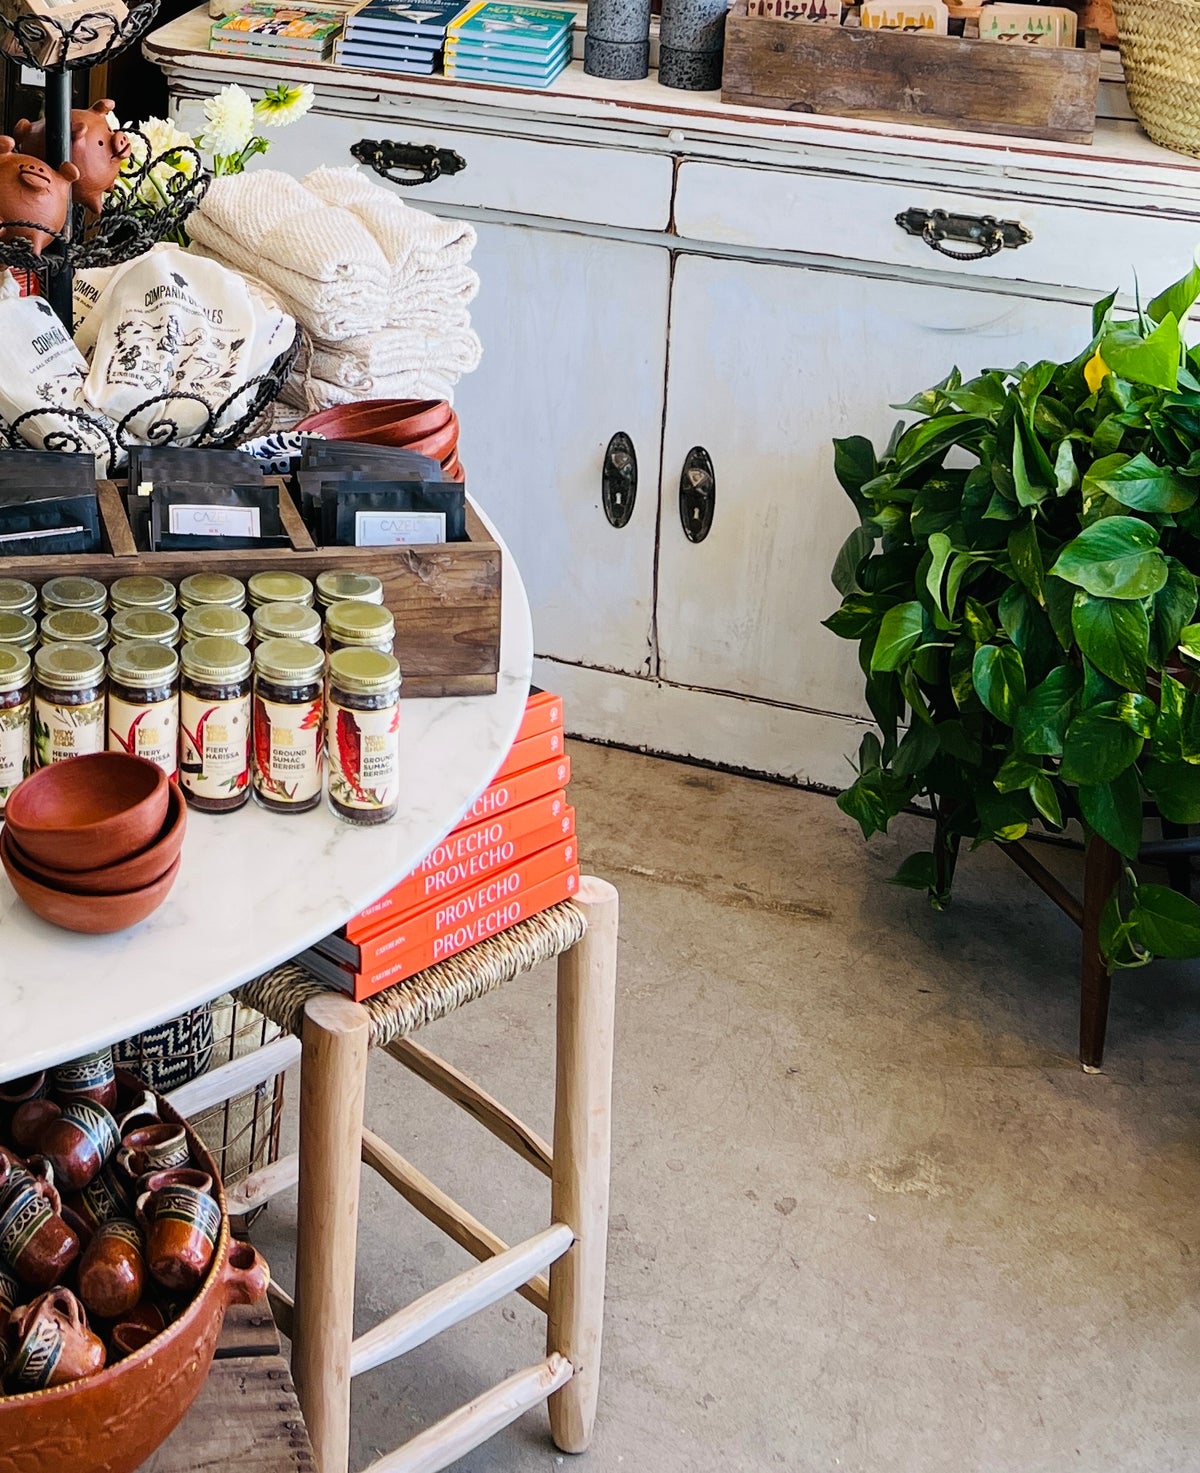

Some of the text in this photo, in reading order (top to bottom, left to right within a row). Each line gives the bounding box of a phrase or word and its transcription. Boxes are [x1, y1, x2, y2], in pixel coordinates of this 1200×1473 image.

[144, 284, 187, 307] COMPAÑIA
[31, 326, 66, 356] COMPAÑIA
[52, 750, 79, 758] HERBY
[205, 752, 240, 760] HARISSA
[363, 754, 394, 764] GROUND
[272, 762, 305, 770] BERRIES
[363, 769, 393, 777] BERRIES
[424, 841, 515, 895] PROVECHO
[434, 872, 521, 931] PROVECHO
[432, 901, 521, 959] PROVECHO
